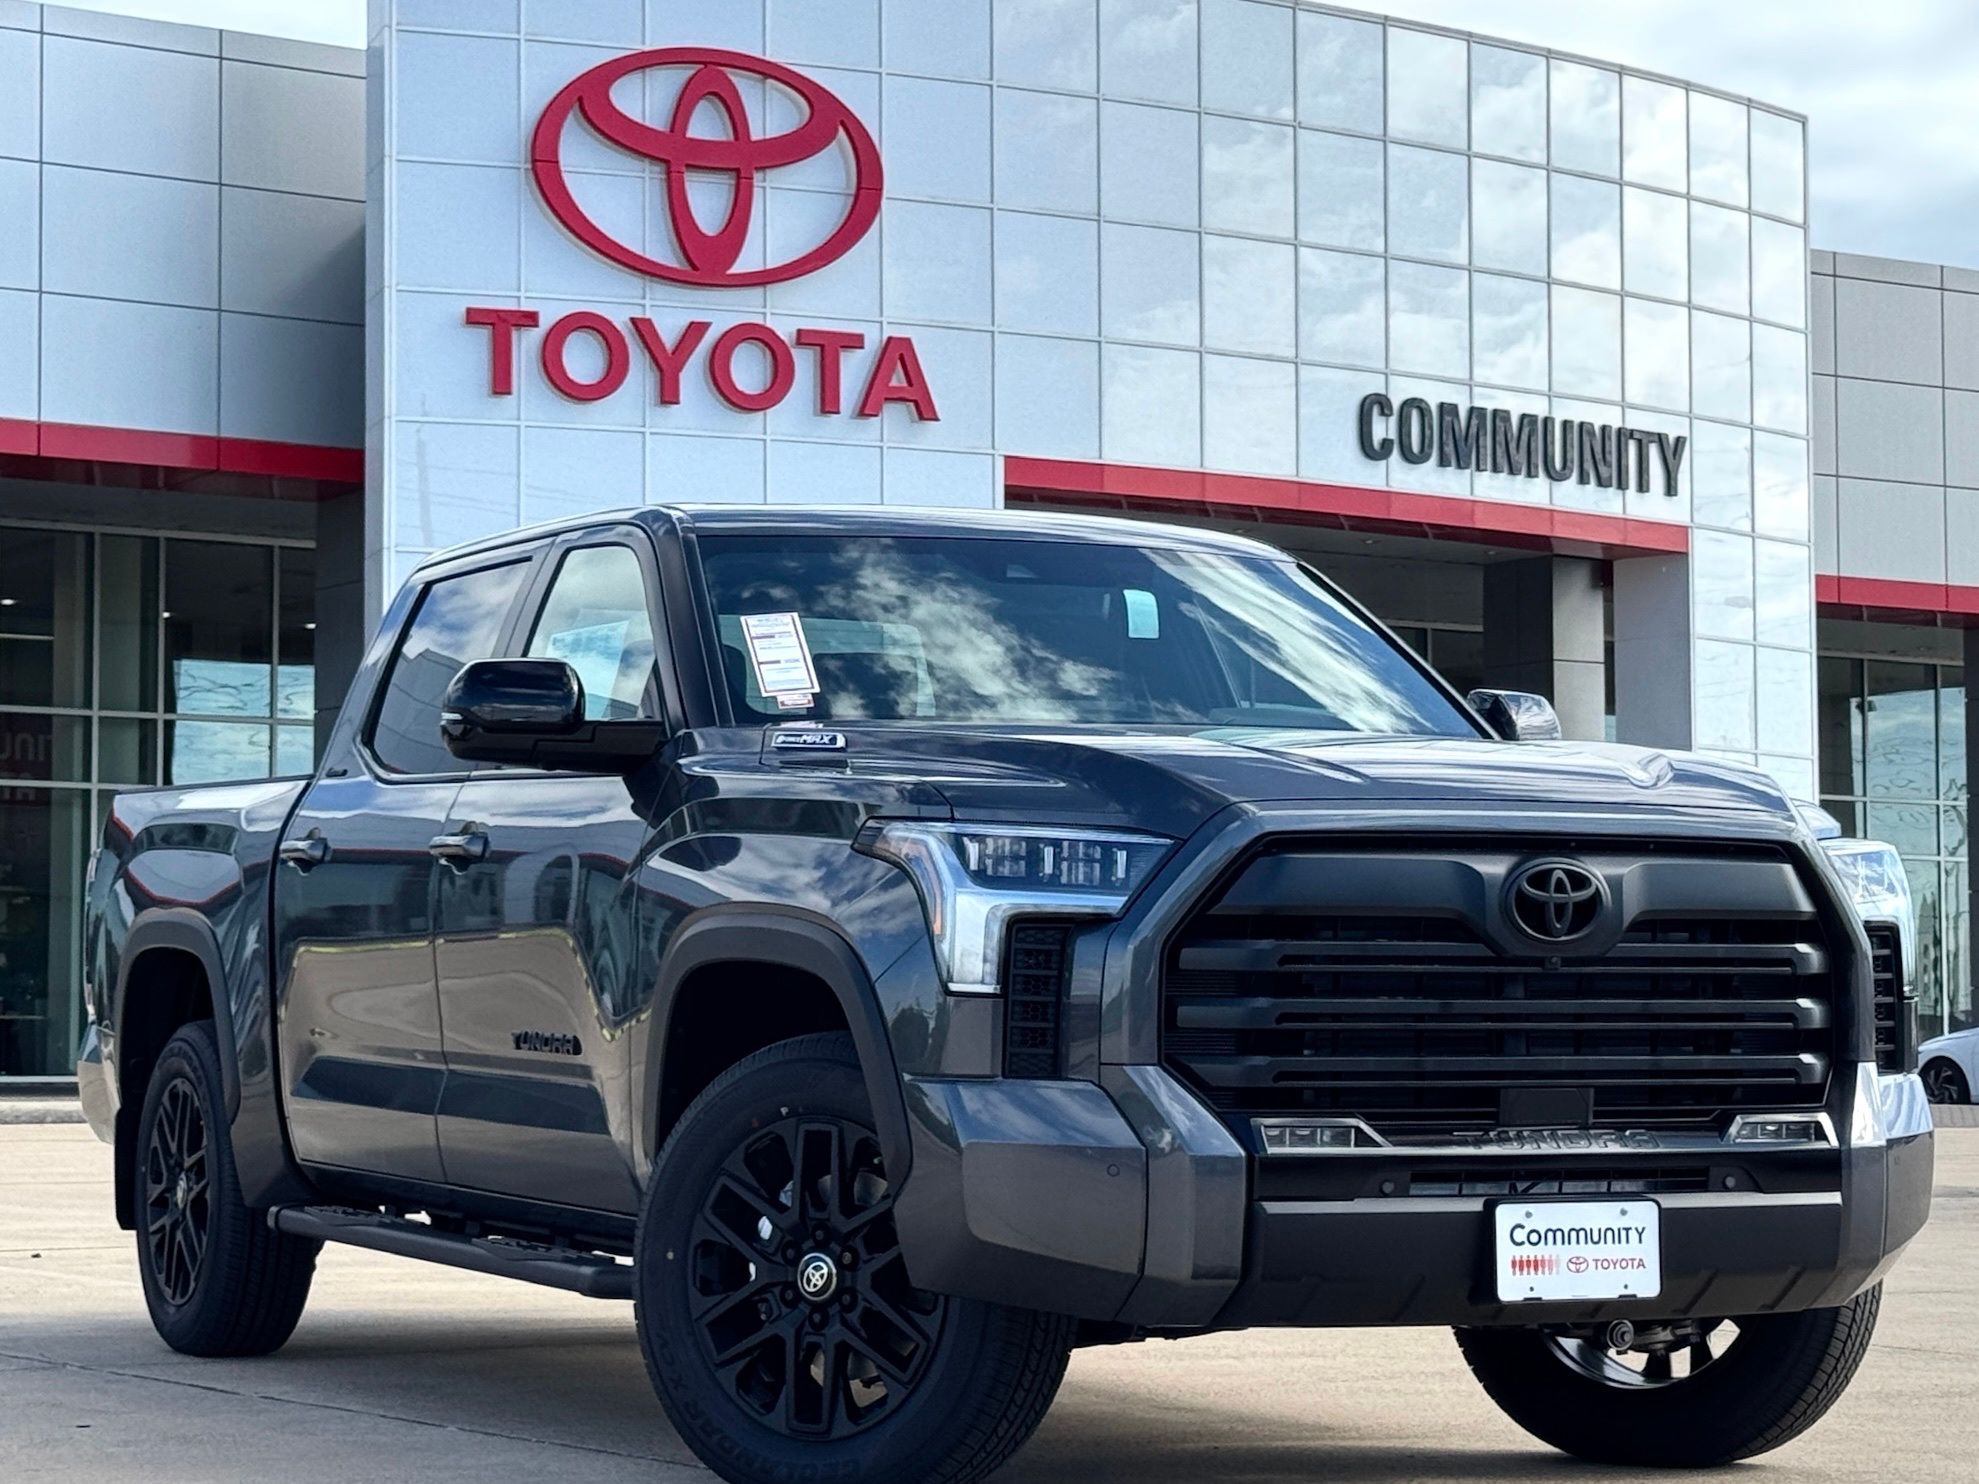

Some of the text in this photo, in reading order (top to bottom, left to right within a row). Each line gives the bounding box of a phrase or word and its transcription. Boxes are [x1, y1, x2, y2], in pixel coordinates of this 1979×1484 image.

[465, 307, 941, 422] TOYOTA
[1359, 393, 1687, 497] COMMUNITY
[800, 734, 833, 744] MAX
[511, 1031, 582, 1056] TUNDRA
[1452, 1129, 1660, 1150] TUNDRA
[1592, 1258, 1646, 1271] TOYOTA
